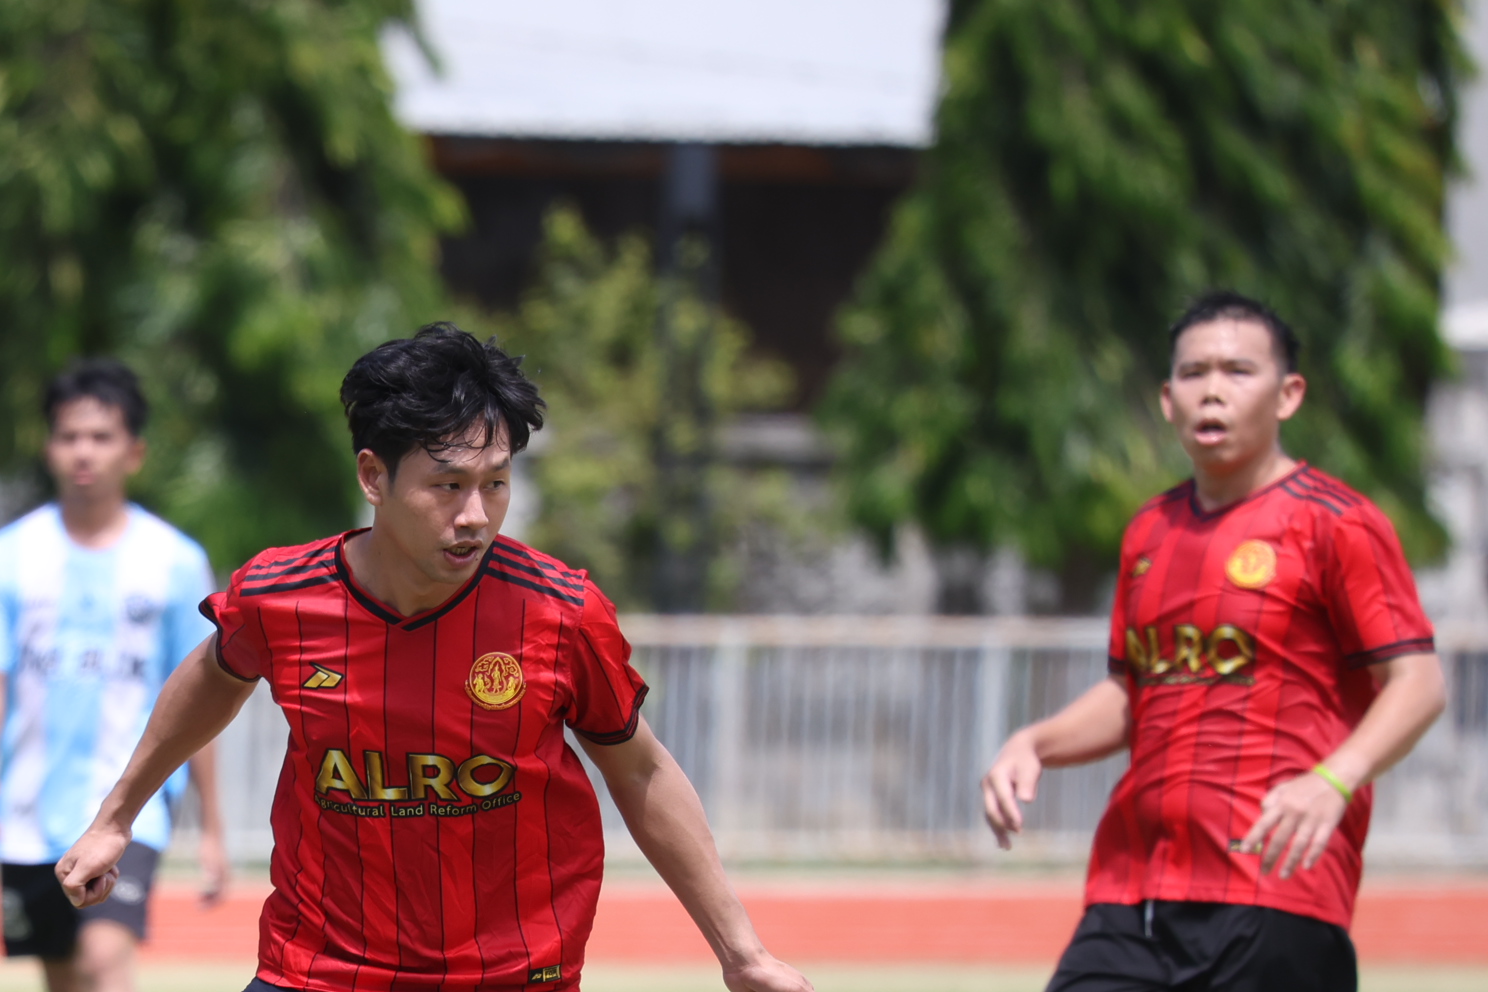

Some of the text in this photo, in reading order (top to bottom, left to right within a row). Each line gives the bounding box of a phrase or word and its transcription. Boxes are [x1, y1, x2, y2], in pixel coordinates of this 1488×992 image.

[314, 747, 517, 801] ALRO
[391, 804, 424, 817] Land
[430, 803, 477, 817] Reform
[481, 792, 521, 811] Office
